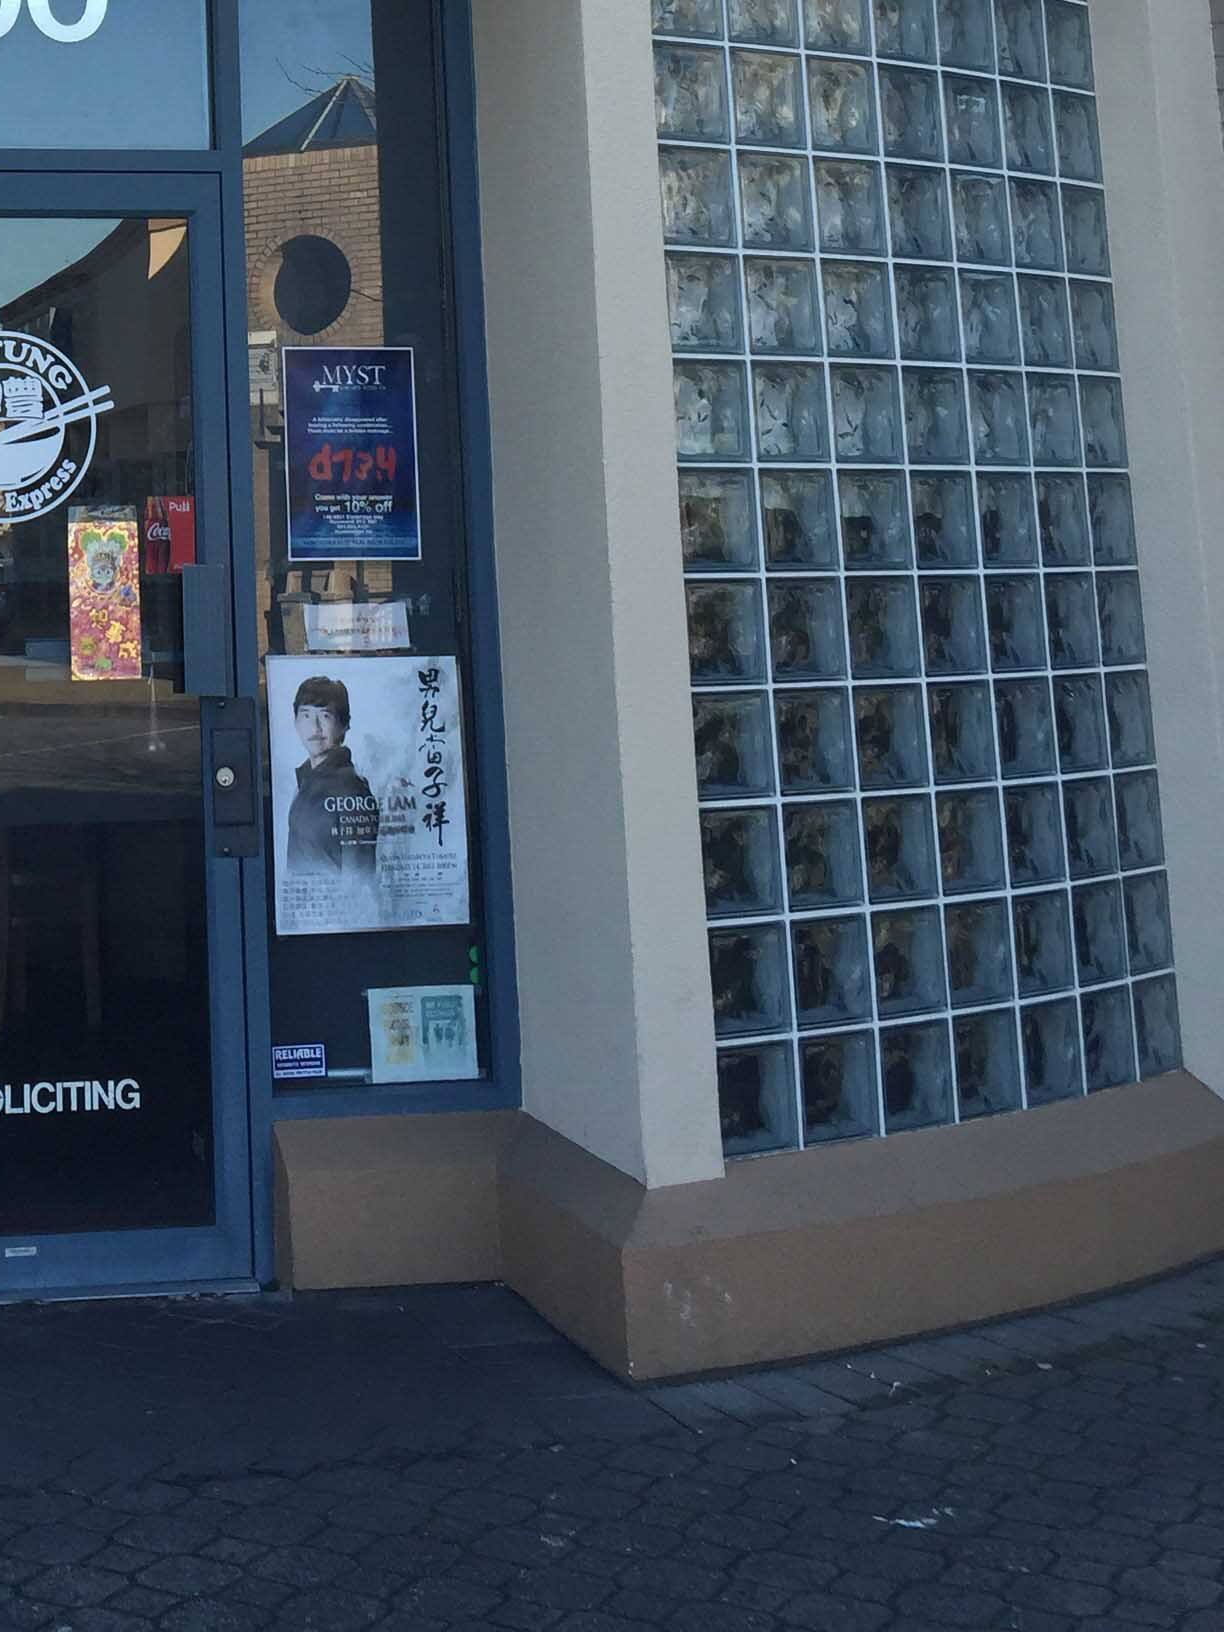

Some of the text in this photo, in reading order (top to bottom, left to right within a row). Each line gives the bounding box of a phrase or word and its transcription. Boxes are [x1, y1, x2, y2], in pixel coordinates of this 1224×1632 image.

[321, 365, 386, 385] MYST
[5, 458, 77, 512] Express
[168, 500, 190, 512] Pull
[344, 500, 372, 513] 10%
[375, 500, 392, 513] off
[324, 795, 416, 812] GEORGE LAM
[275, 1048, 322, 1060] RELIABLE
